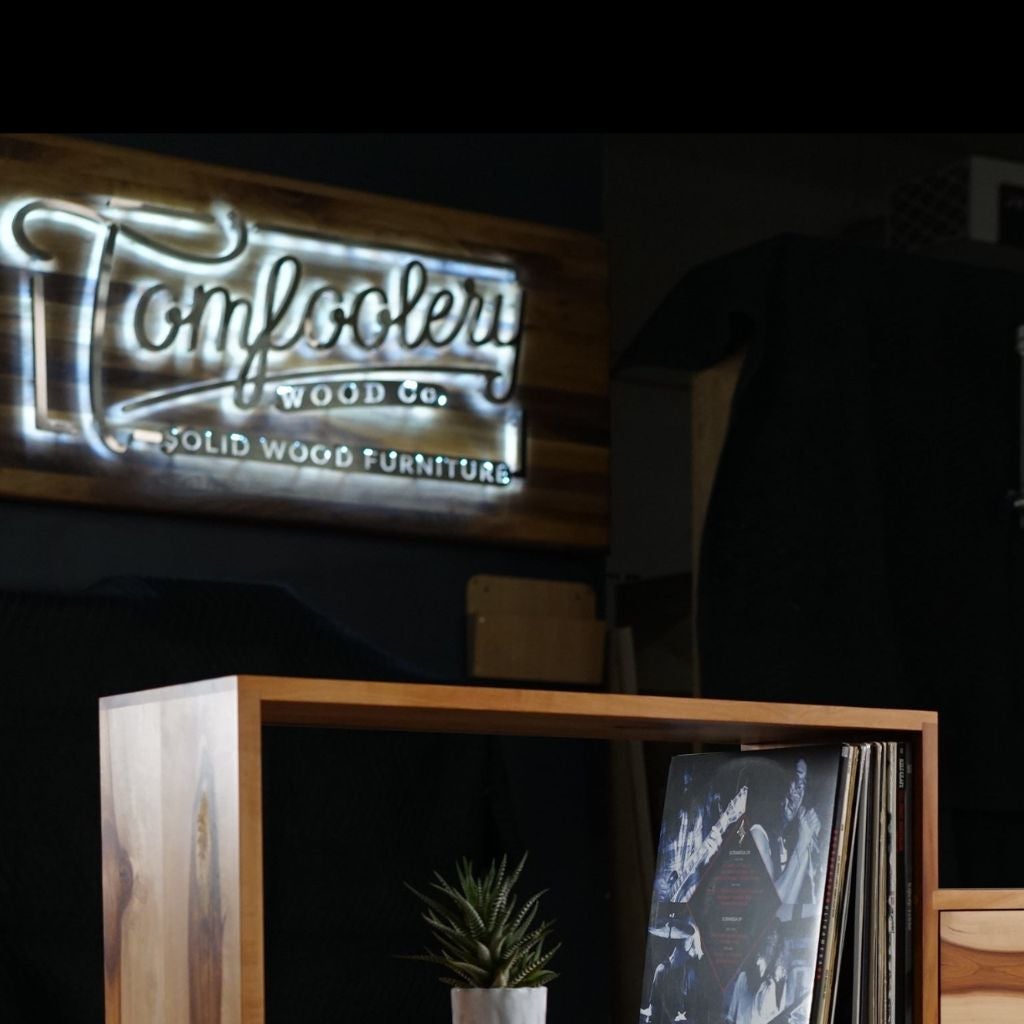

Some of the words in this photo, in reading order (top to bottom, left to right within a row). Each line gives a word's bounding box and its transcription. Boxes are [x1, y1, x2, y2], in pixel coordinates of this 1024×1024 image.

[9, 198, 526, 454] Tomfoolery
[277, 382, 385, 410] WOOD
[163, 427, 250, 458] SOLID
[259, 437, 354, 468] WOOD
[363, 448, 512, 485] FURNITURE
